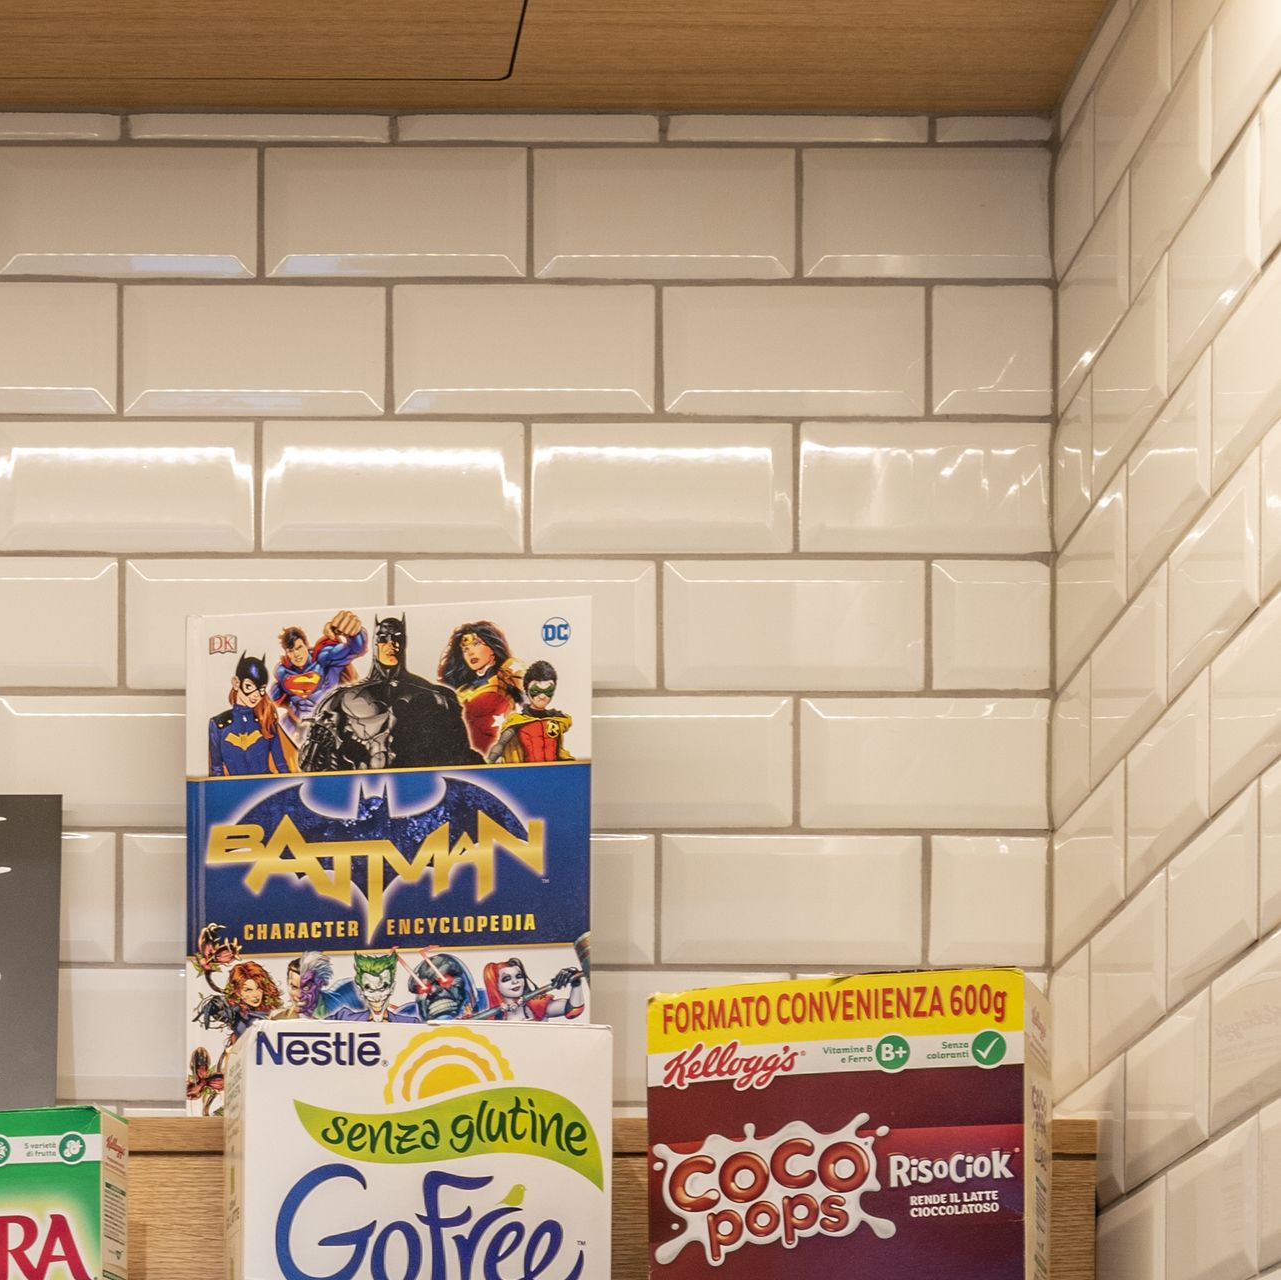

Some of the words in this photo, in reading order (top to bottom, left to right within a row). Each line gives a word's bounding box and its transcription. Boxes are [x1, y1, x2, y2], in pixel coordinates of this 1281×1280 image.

[212, 634, 235, 652] DK
[542, 623, 569, 642] DC
[206, 810, 545, 946] BATMAN
[242, 919, 359, 942] CHARACTER
[385, 913, 537, 937] ENCYCLOPEDIA
[662, 994, 771, 1035] FORMATO
[776, 986, 946, 1025] CONVENIENZA
[949, 983, 1008, 1023] 600g
[256, 1031, 381, 1067] Nestlé
[823, 1046, 864, 1056] Vitamine
[866, 1045, 873, 1053] B
[926, 1051, 969, 1060] coloranti
[941, 1041, 969, 1050] Senza
[662, 1040, 799, 1089] Kellogg's
[848, 1055, 873, 1063] Ferro
[321, 1115, 439, 1155] senza
[449, 1096, 588, 1157] glutine
[668, 1137, 871, 1213] COCO
[909, 1193, 946, 1207] RENDE
[949, 1192, 960, 1205] IL
[961, 1190, 999, 1204] LATTE
[909, 1202, 1000, 1218] CIOCCOLATOSO
[707, 1193, 850, 1261] pops
